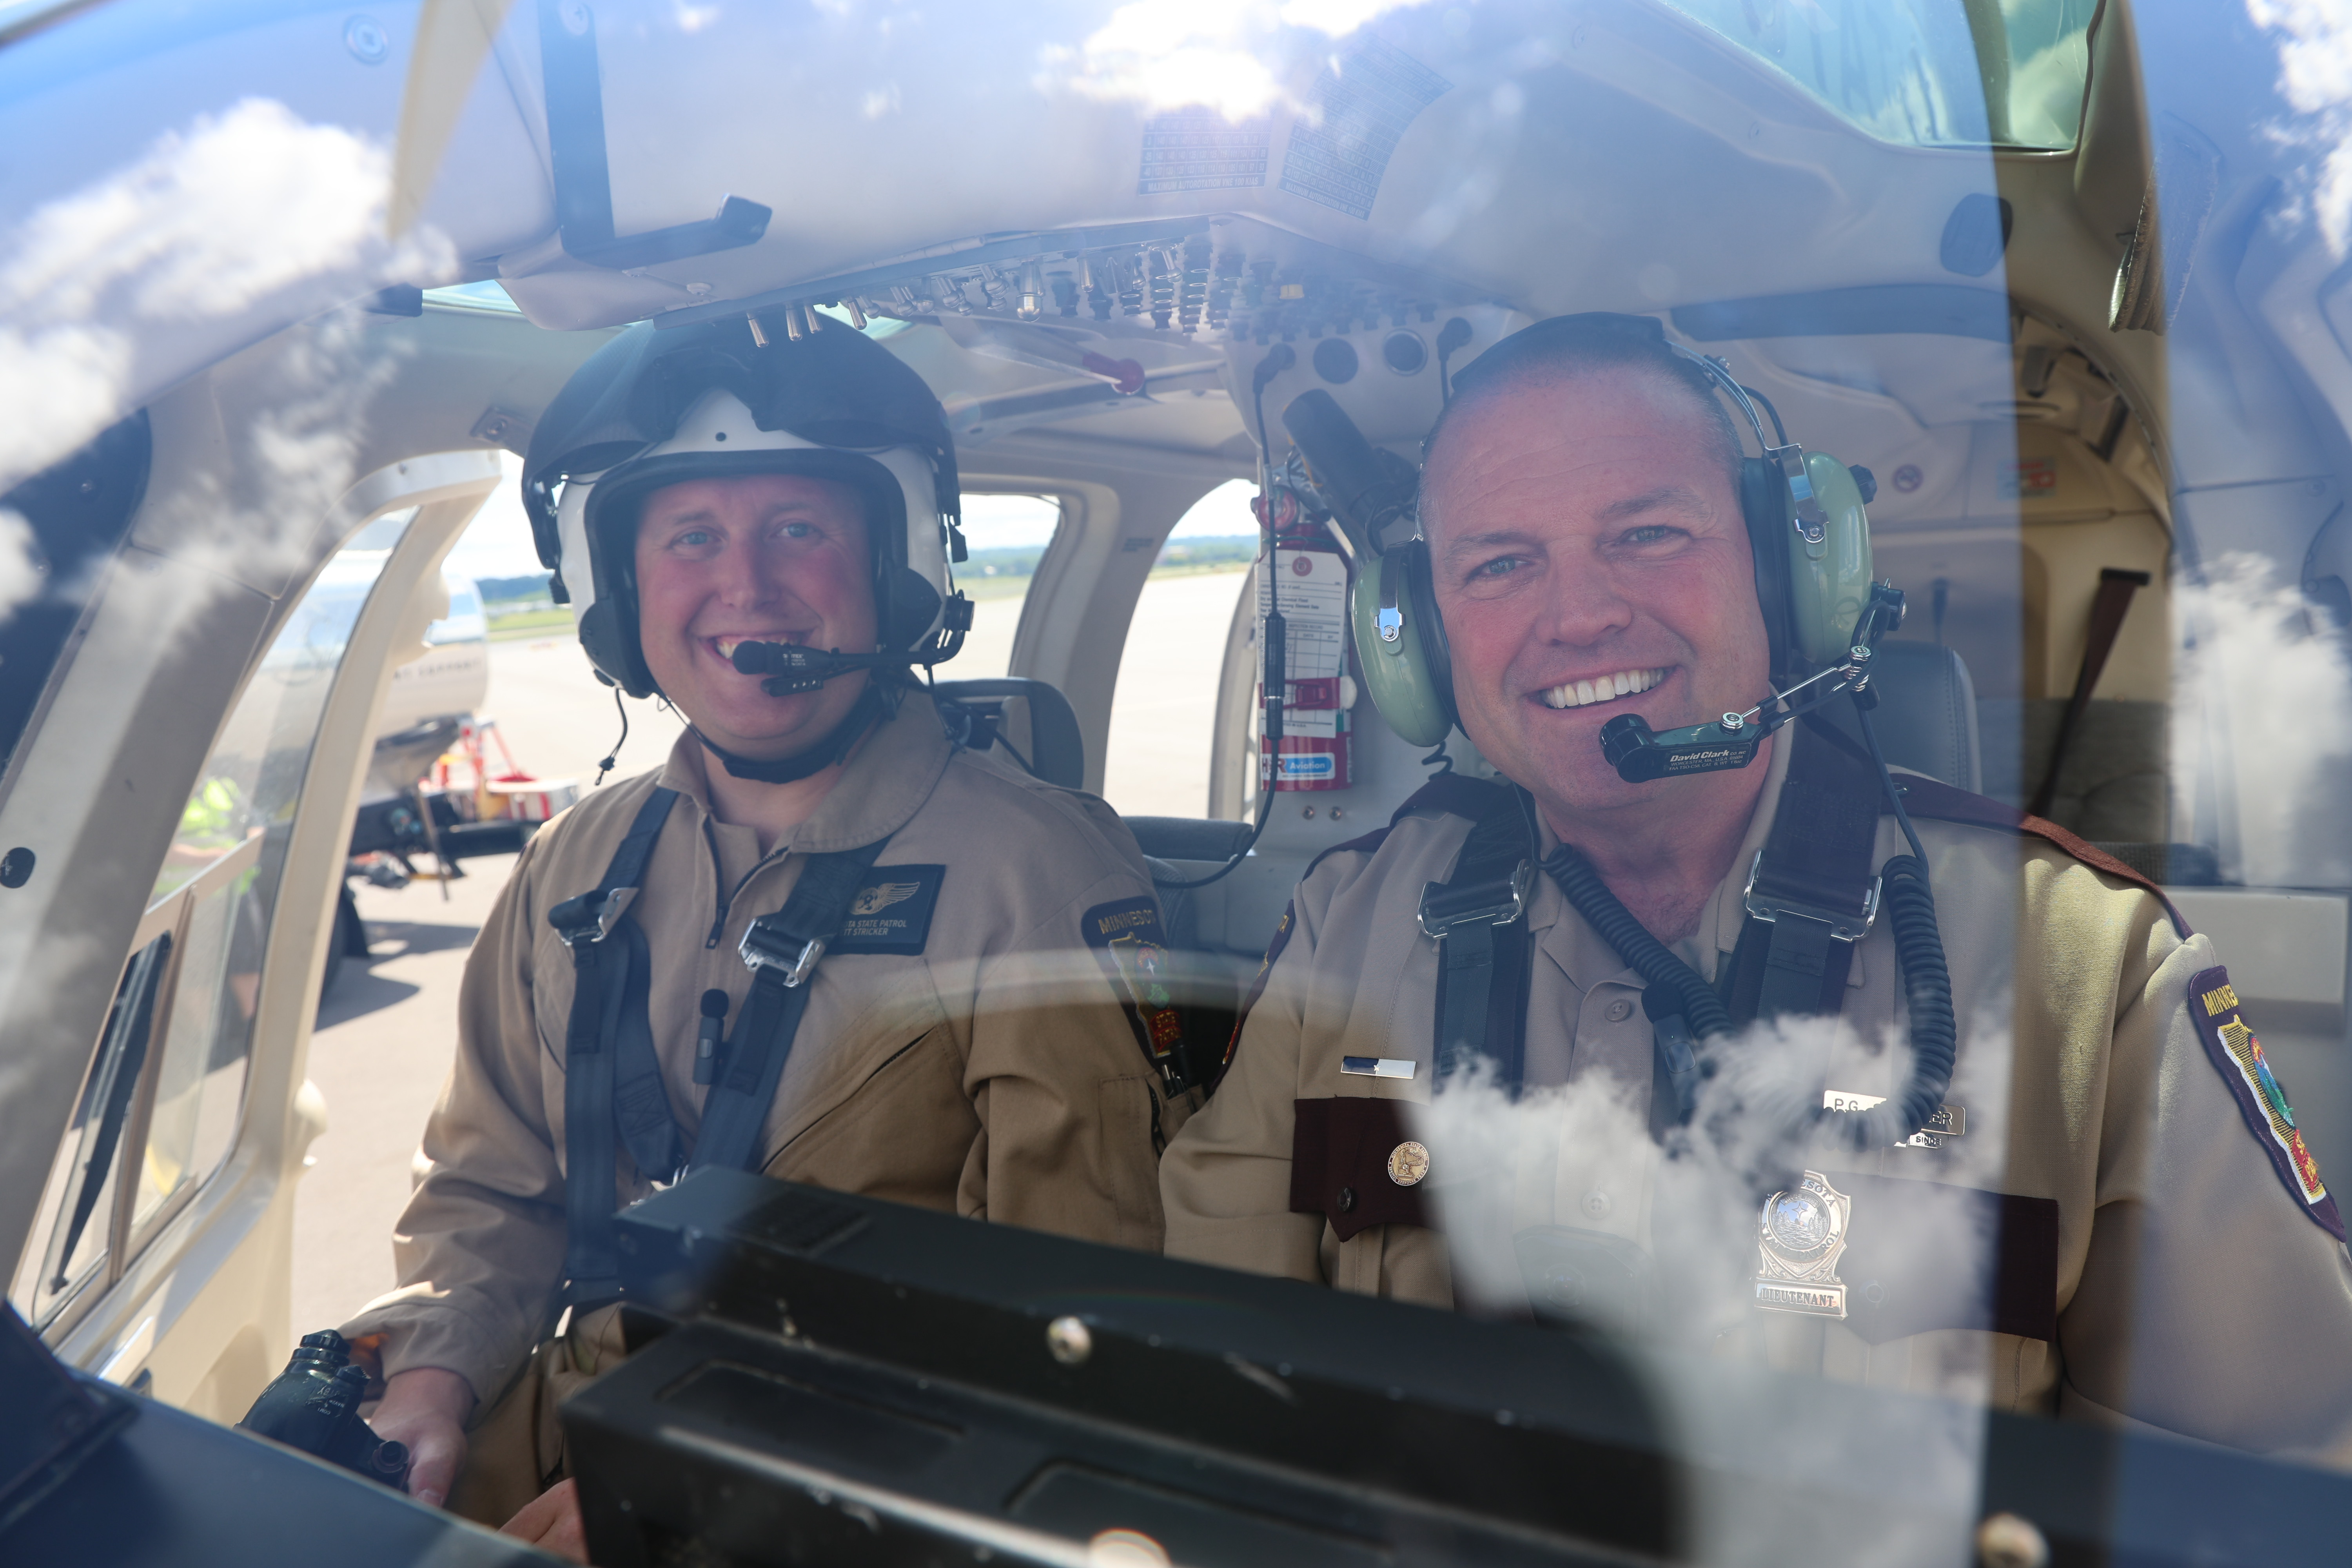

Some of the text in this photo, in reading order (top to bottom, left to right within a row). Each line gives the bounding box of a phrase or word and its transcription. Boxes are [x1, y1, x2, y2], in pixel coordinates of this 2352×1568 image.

[1249, 163, 1254, 171] 97
[1259, 163, 1264, 171] 93
[1148, 181, 1177, 192] MAXIMUM
[1178, 178, 1221, 187] AUTOROTATION
[1235, 178, 1244, 186] 100
[1285, 182, 1308, 197] MAXIMUM
[1308, 192, 1339, 209] AUTOROTATION
[1340, 203, 1349, 211] VNE
[1355, 209, 1365, 218] KIAS
[1670, 752, 1701, 762] David
[1701, 750, 1730, 759] Clark
[1262, 757, 1325, 773] HR Aviation
[858, 920, 878, 928] STATE
[879, 919, 907, 927] PATROL
[1098, 909, 1156, 935] MINNESOT
[2201, 984, 2239, 1017] MINNE
[1156, 1011, 1176, 1028] STATE
[1158, 1027, 1181, 1045] PATRO
[1916, 1136, 1942, 1146] SINCE
[1392, 1143, 1409, 1158] MINNESOTA
[1797, 1230, 1839, 1259] PATROL
[1760, 1288, 1835, 1308] LIEUTENANT
